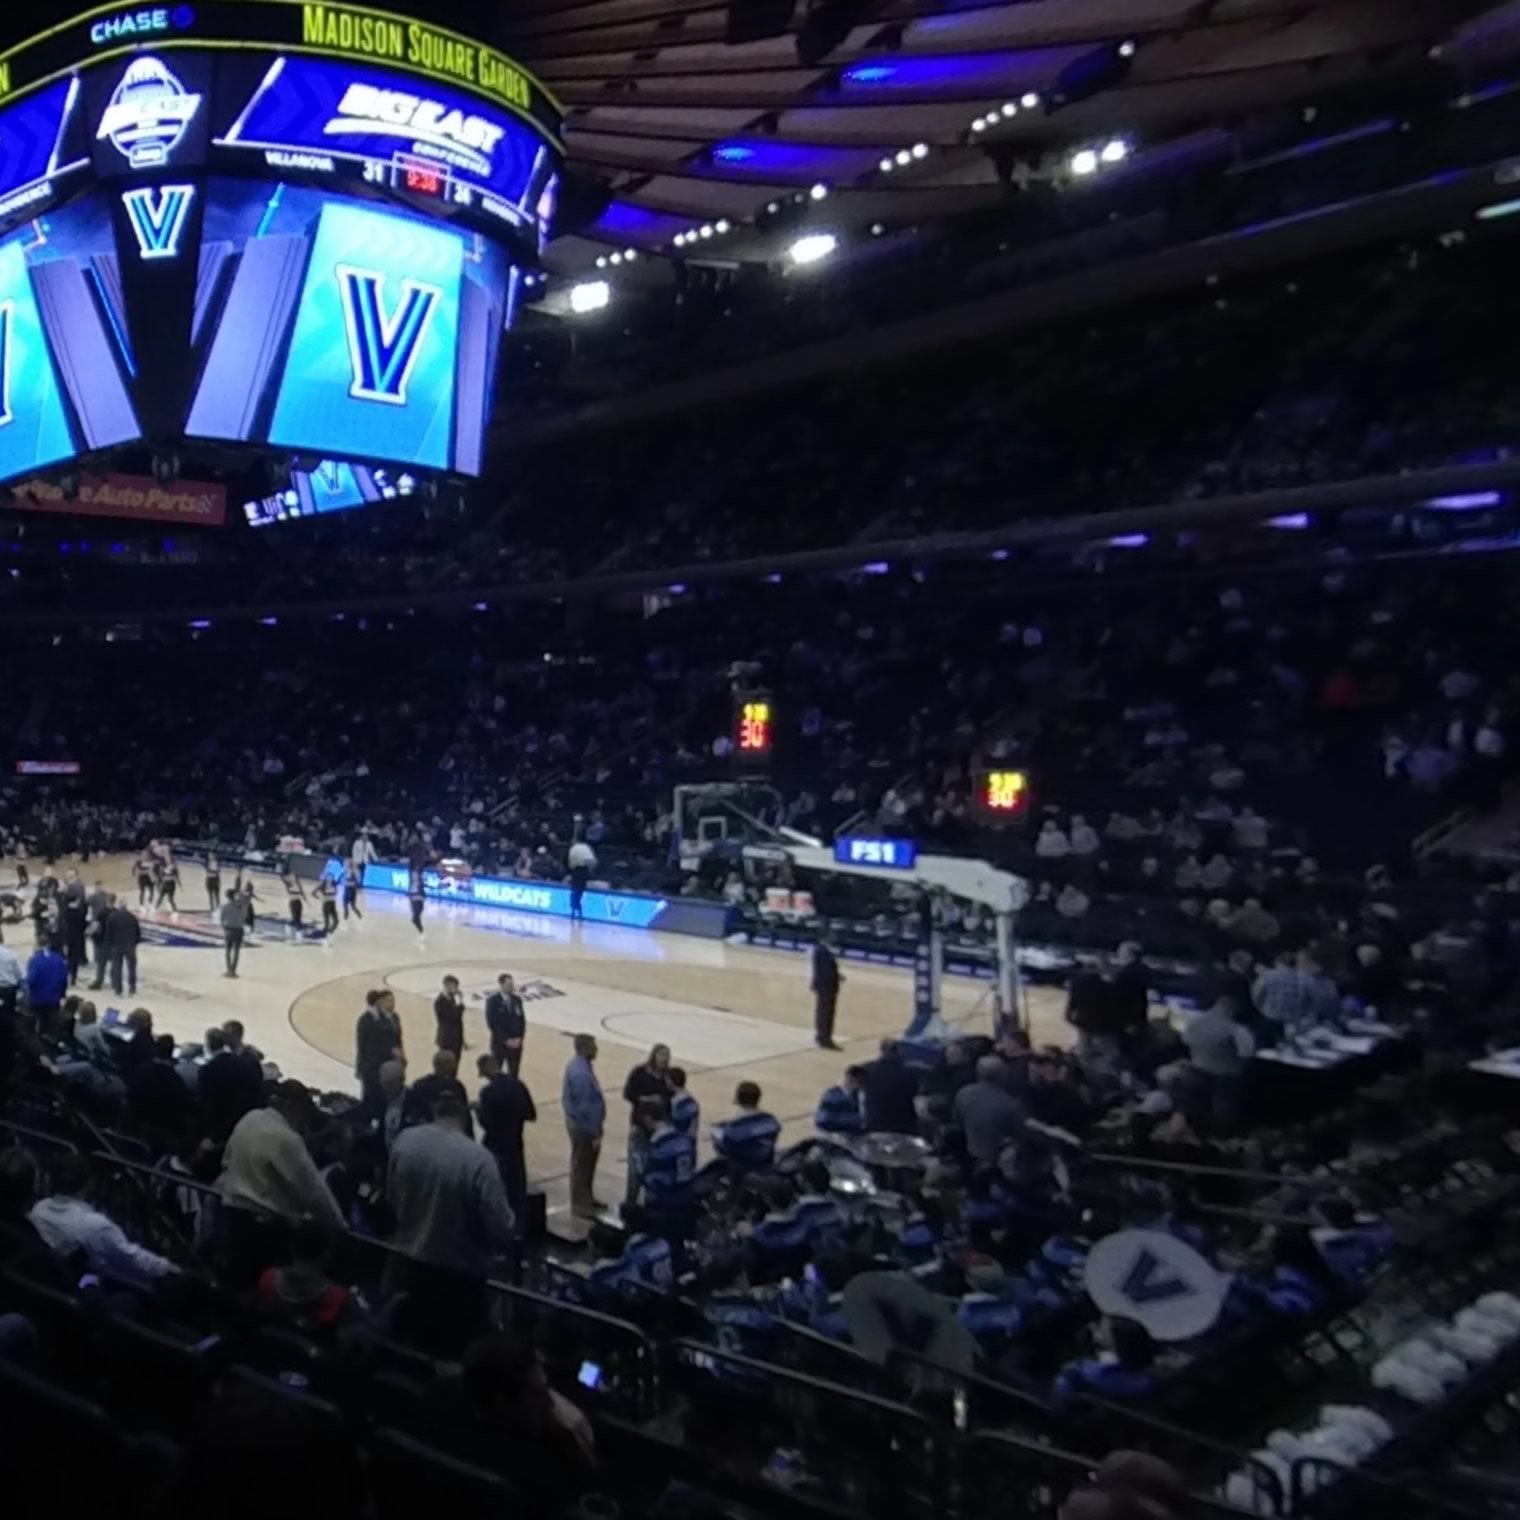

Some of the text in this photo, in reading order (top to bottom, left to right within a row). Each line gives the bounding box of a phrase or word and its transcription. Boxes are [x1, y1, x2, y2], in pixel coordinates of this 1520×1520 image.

[91, 9, 169, 43] CHASE
[303, 4, 529, 109] MADISON SQUARE GARDEN
[412, 98, 505, 152] EAST
[265, 151, 333, 171] VILLANOVA
[364, 161, 383, 182] 31
[123, 185, 195, 259] V
[336, 263, 442, 405] V
[93, 483, 143, 508] Auto
[144, 487, 198, 513] Parts
[851, 840, 895, 863] FS1
[473, 881, 553, 909] WILDCATS
